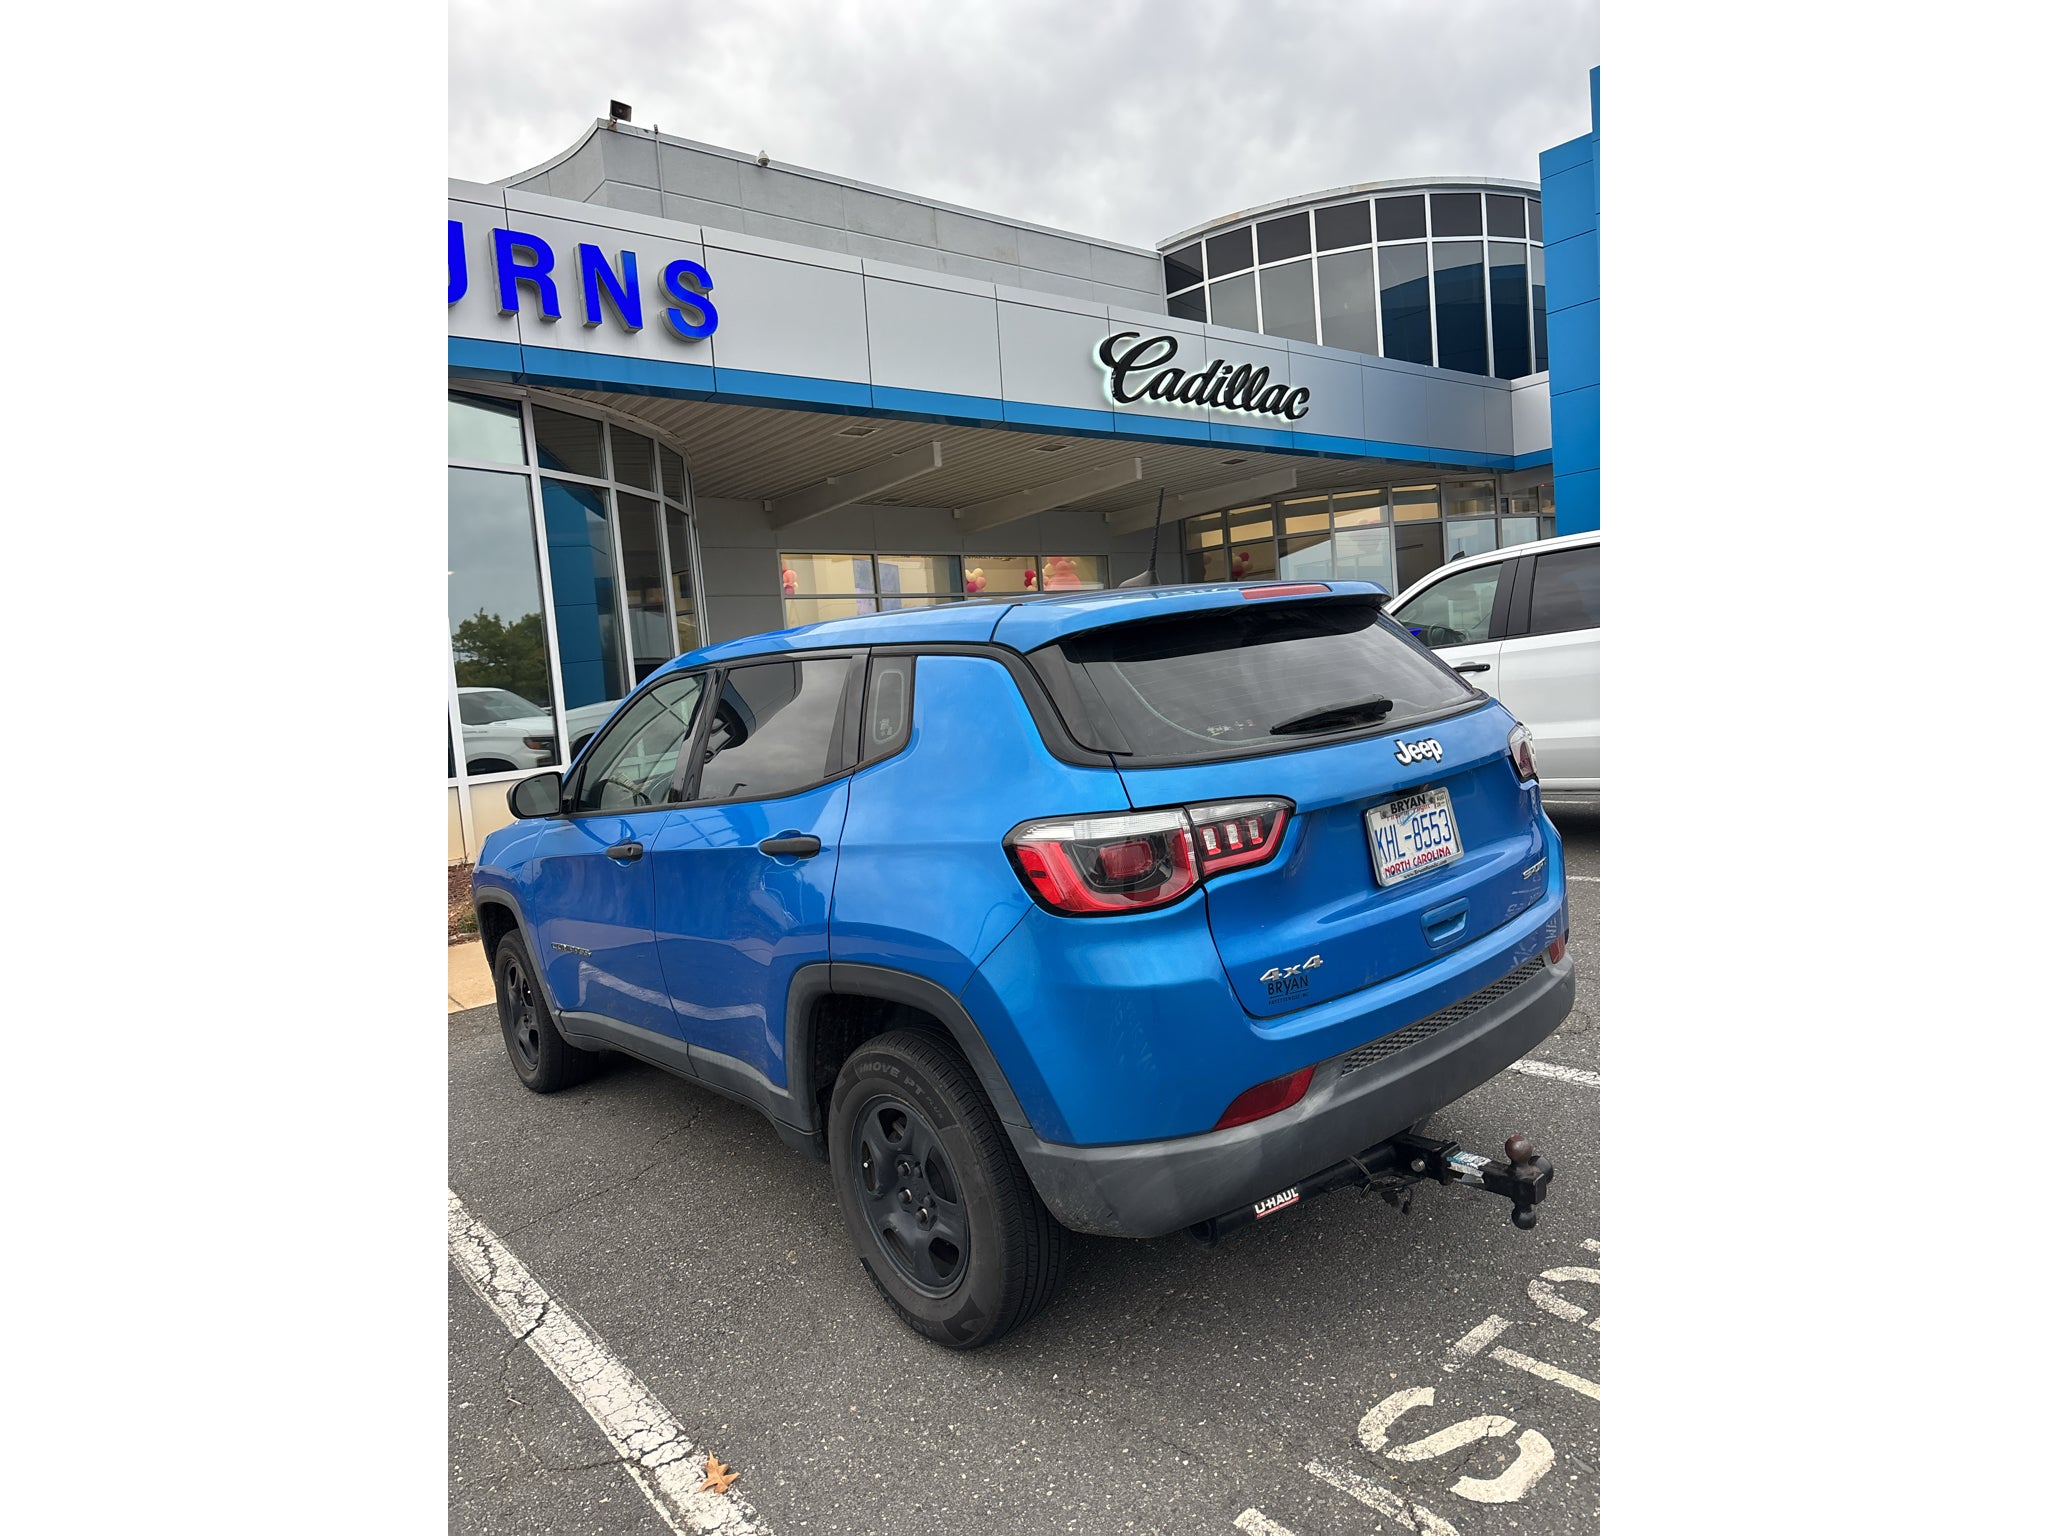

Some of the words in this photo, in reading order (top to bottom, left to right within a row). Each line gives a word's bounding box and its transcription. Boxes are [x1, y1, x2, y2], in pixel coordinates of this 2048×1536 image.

[1099, 331, 1310, 420] Cadillac
[1394, 738, 1443, 766] Jeep
[1390, 794, 1426, 814] BRYAN
[1374, 808, 1453, 863] KHL-8553
[1384, 859, 1411, 877] NORTH
[1413, 845, 1452, 867] CAROLINA
[1260, 954, 1324, 982] 4x4
[1267, 976, 1309, 995] BRYAN
[903, 1075, 926, 1096] PT
[1254, 1188, 1299, 1215] U-HAUL
